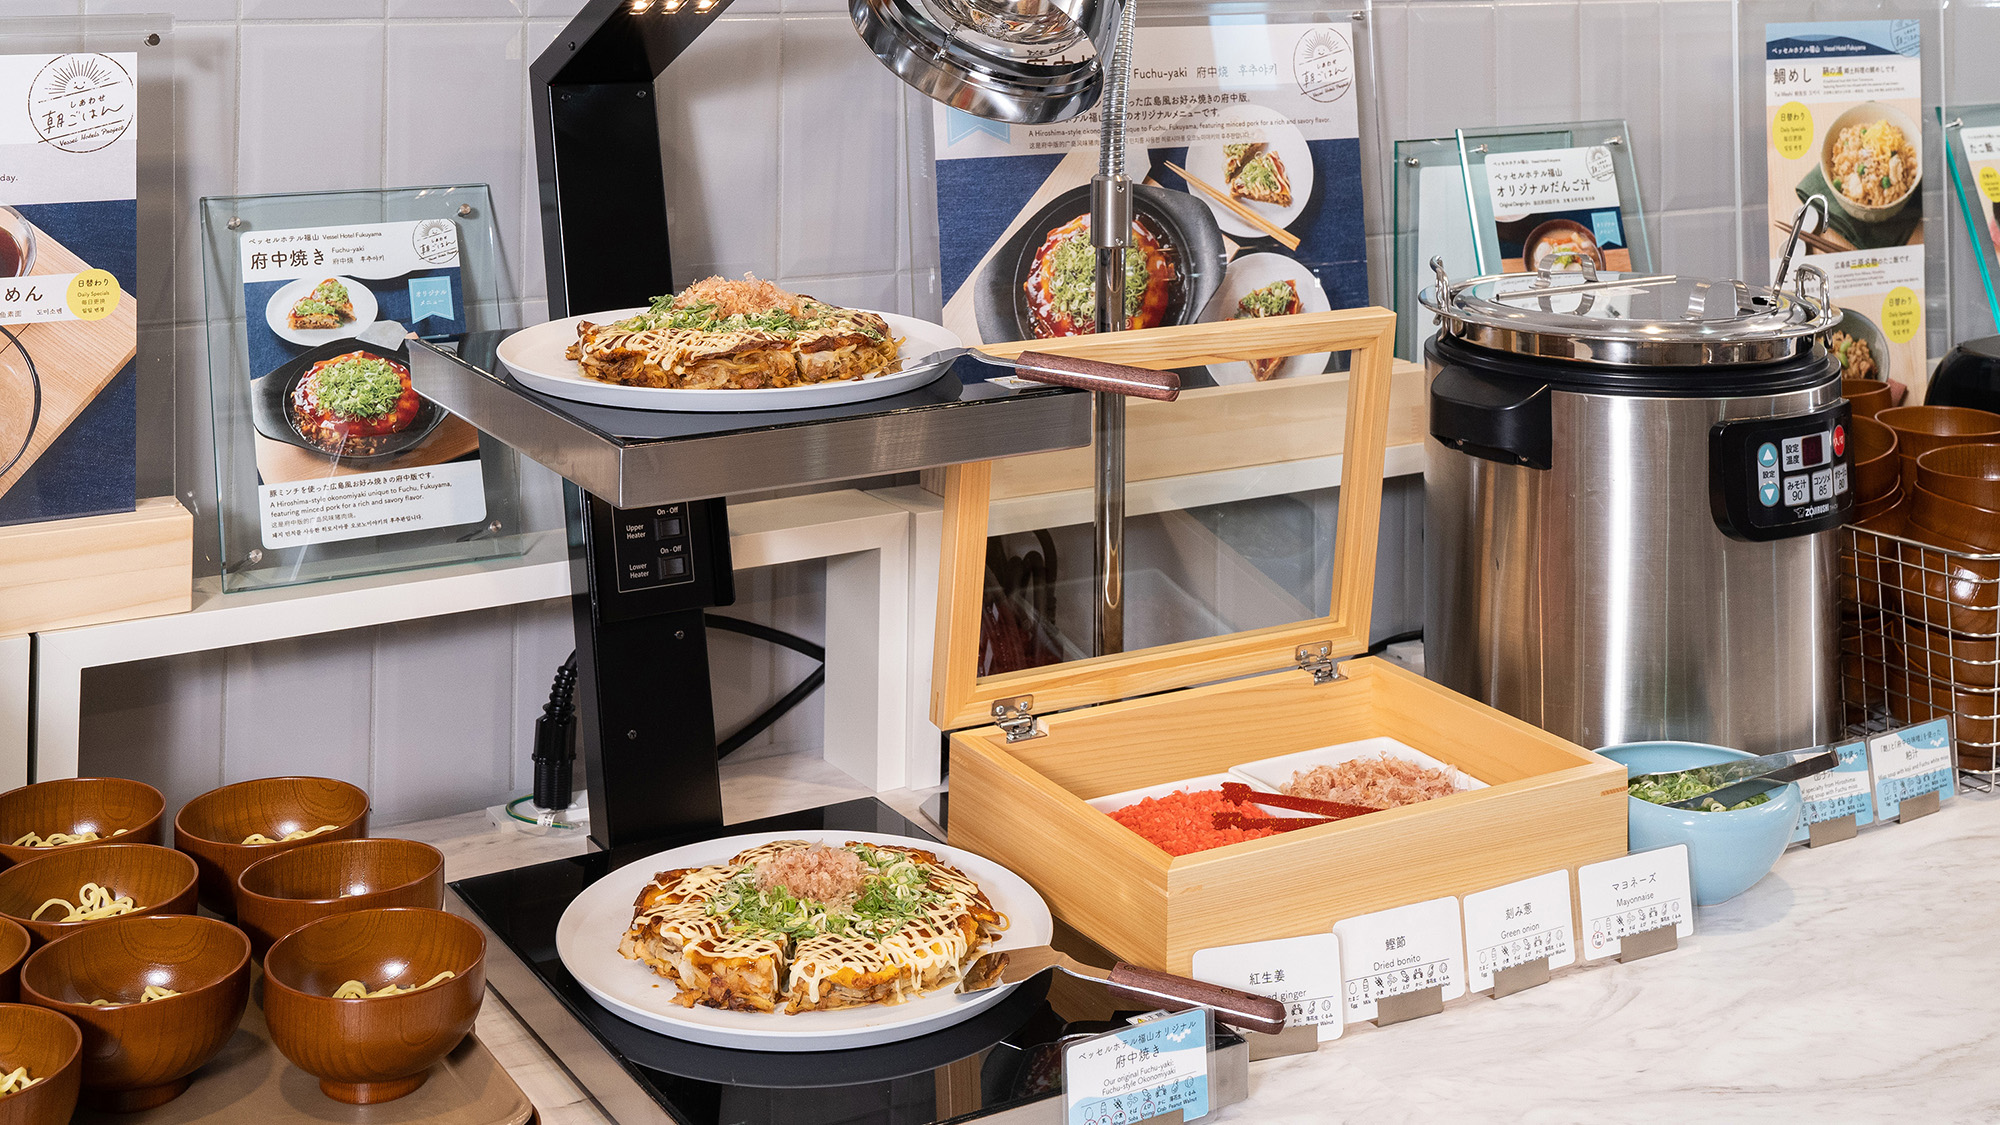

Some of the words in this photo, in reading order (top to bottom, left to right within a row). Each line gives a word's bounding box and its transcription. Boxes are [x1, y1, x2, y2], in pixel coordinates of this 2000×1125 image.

[1133, 66, 1187, 81] Fuchu-yaki
[1773, 68, 1812, 85] 鯛めし
[70, 94, 106, 108] しあわせ
[42, 104, 124, 135] 朝ごはん
[1035, 128, 1081, 137] Hiroshima-style
[1199, 121, 1225, 129] featuring
[1226, 120, 1246, 128] minced
[1247, 119, 1259, 128] pork
[1297, 118, 1314, 126] savory
[1494, 168, 1563, 180] ベッセルホテル福山
[1497, 179, 1591, 198] オリジナルだんご汁
[248, 234, 320, 245] ベッセルホテル福山
[355, 231, 382, 239] Fukuyama
[331, 245, 365, 254] Fuchu-yaki
[250, 248, 324, 270] 府中焼き
[78, 278, 109, 288] 日替わり
[5, 285, 43, 303] めん
[415, 289, 447, 298] オリジナル
[1785, 443, 1800, 454] 設定
[1762, 469, 1776, 479] 設定
[1814, 473, 1831, 486] コンソメ
[1787, 479, 1807, 491] みそ汁
[1818, 484, 1828, 496] 85
[276, 497, 326, 507] Hiroshima-style
[327, 490, 366, 502] okonomiyaki
[367, 488, 389, 498] unique
[398, 485, 419, 493] Fuchu,
[420, 481, 452, 491] Fukuyama,
[1792, 490, 1803, 501] 90
[270, 509, 300, 518] featuring
[300, 506, 325, 514] minced
[325, 503, 340, 513] pork
[357, 499, 370, 507] rich
[371, 498, 383, 506] and
[384, 496, 403, 504] savory
[656, 508, 666, 516] On
[669, 506, 679, 514] Off
[625, 523, 644, 532] Upper
[626, 531, 646, 540] Heater
[672, 545, 682, 553] Off
[629, 563, 647, 571] Lower
[630, 571, 650, 579] Heater
[1611, 872, 1657, 892] マヨネーズ
[1616, 892, 1655, 908] Mayonnaise
[1501, 928, 1521, 940] Green
[1521, 922, 1540, 934] onion
[1385, 935, 1407, 952] 鰹節
[1373, 959, 1395, 972] Dried
[1396, 953, 1422, 967] bonito
[1249, 969, 1285, 986] 紅生姜
[1280, 989, 1307, 1002] ginger
[1078, 1020, 1197, 1060] ベッセルホテル福山オリジナル
[1115, 1044, 1161, 1070] 府中焼き
[1102, 1080, 1137, 1096] Fuchu-style
[1137, 1067, 1177, 1085] Okonomiyaki
[1103, 1078, 1116, 1087] Our
[1116, 1069, 1140, 1083] original
